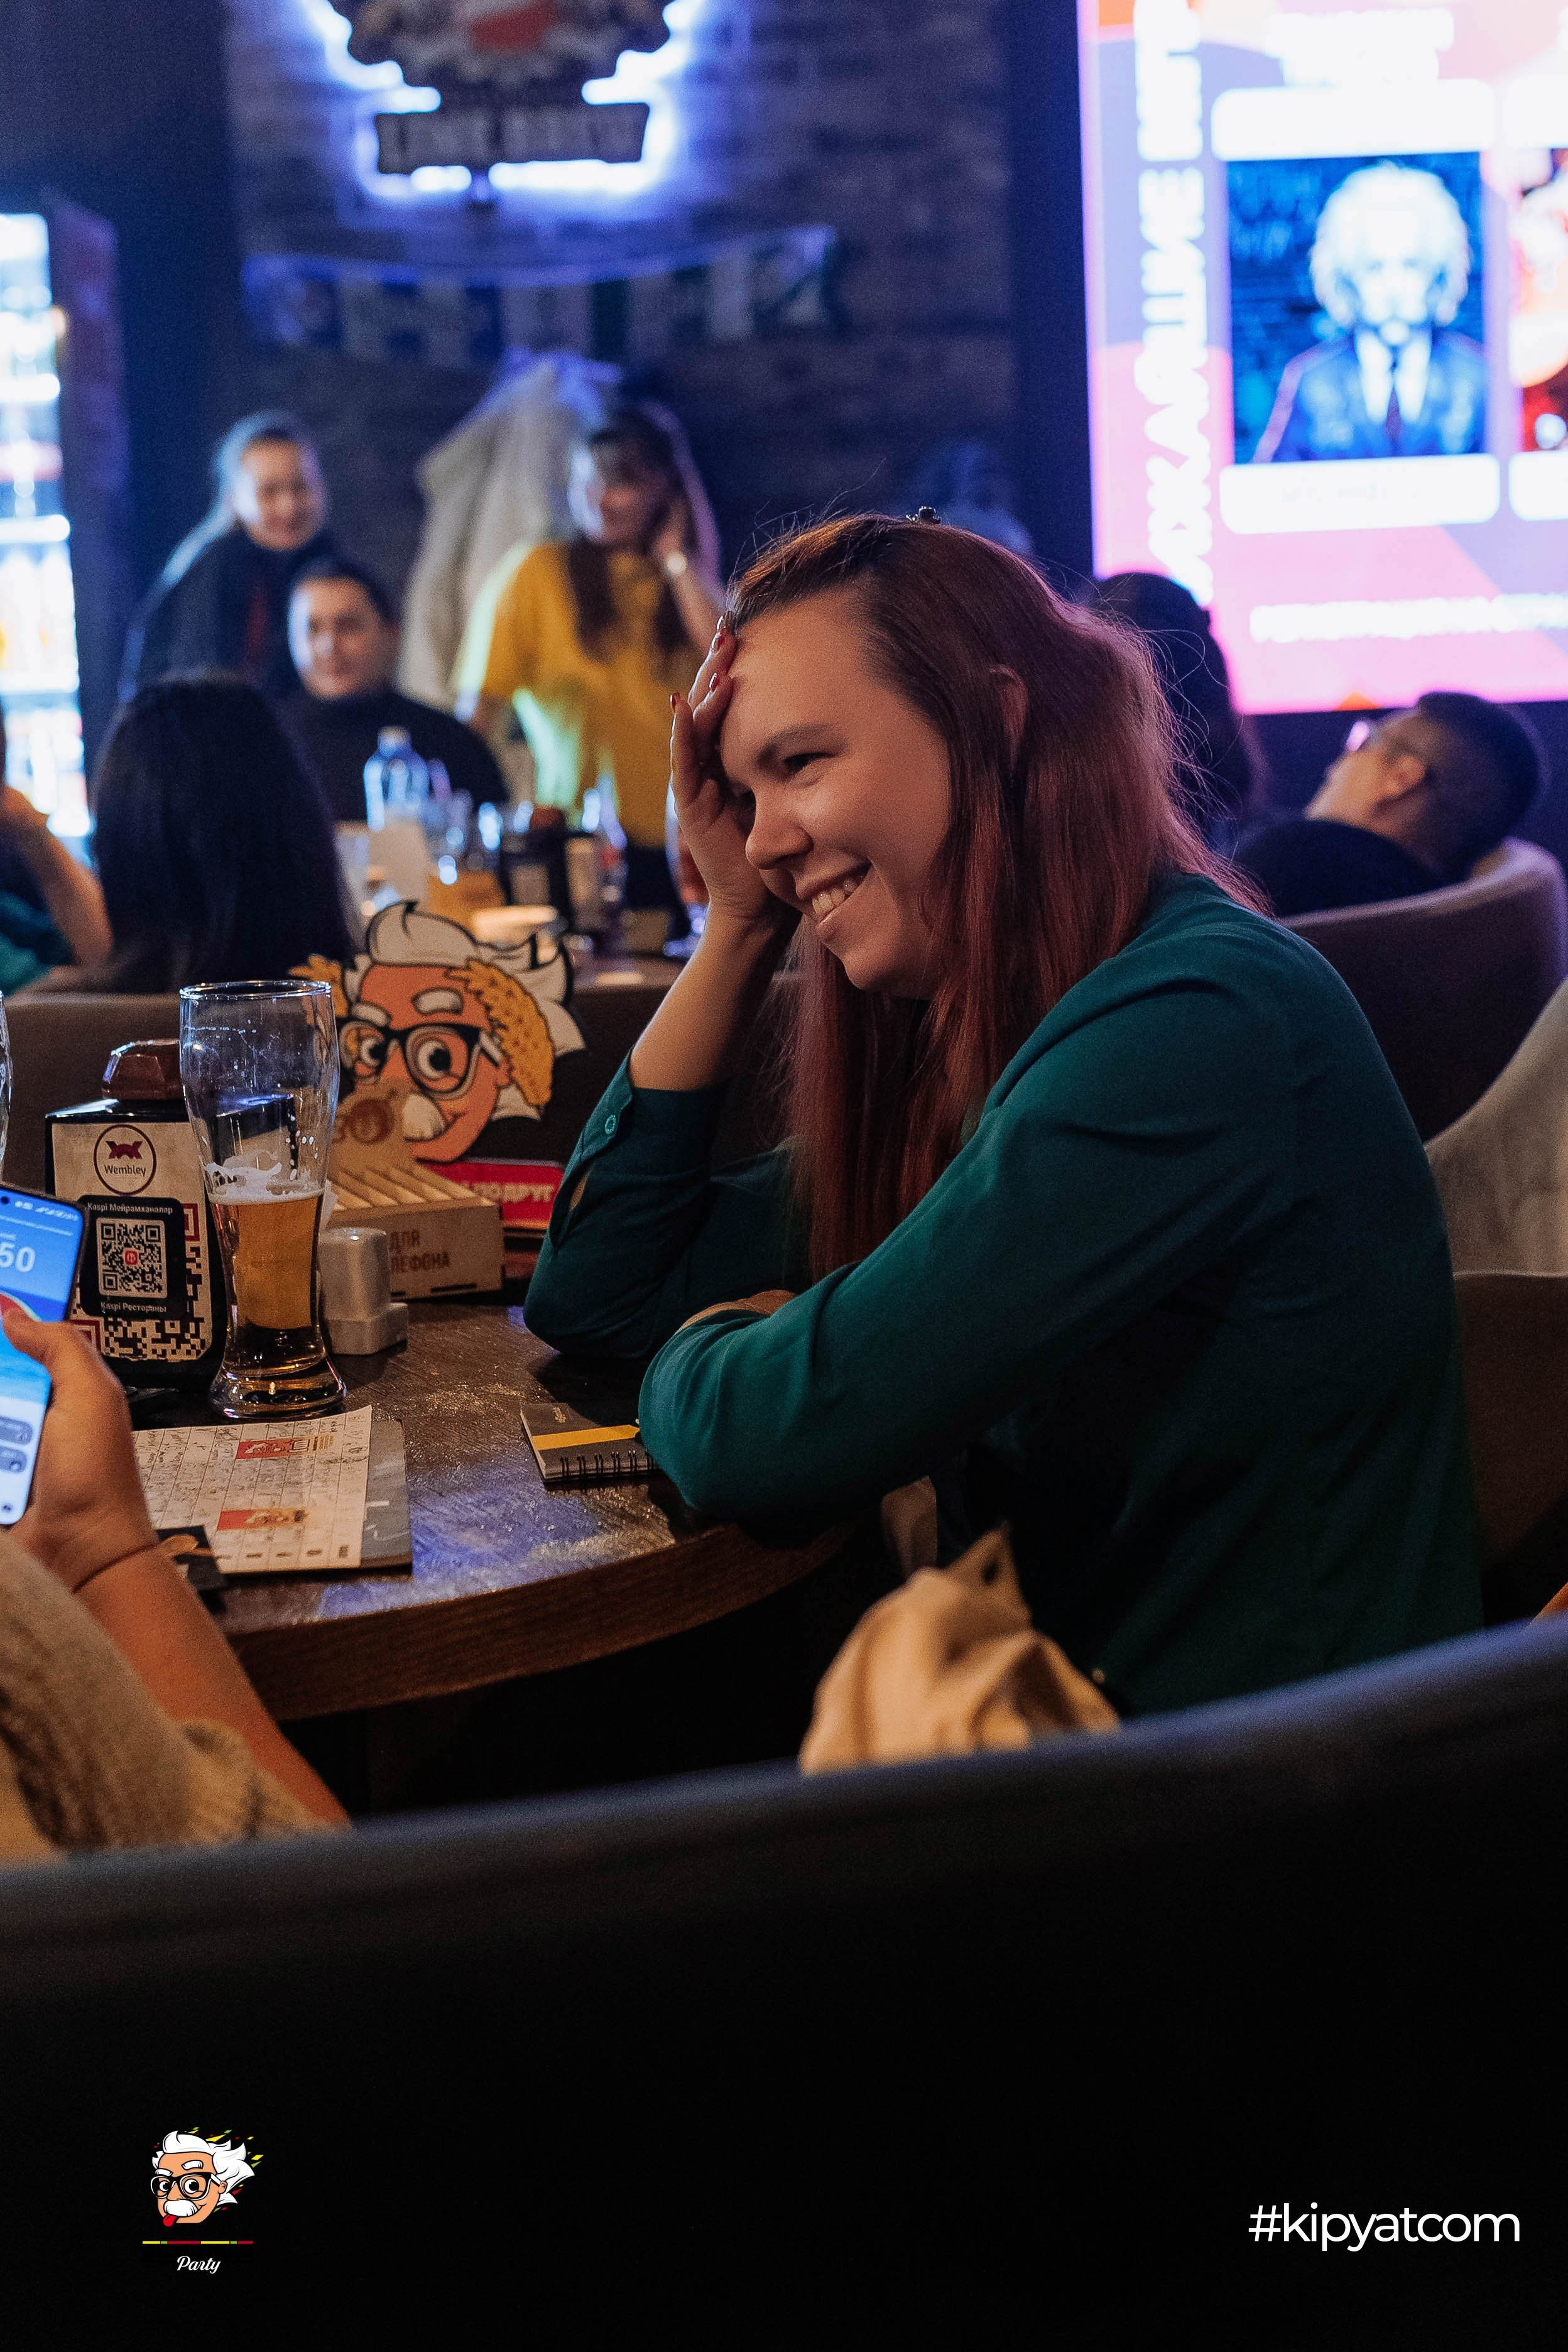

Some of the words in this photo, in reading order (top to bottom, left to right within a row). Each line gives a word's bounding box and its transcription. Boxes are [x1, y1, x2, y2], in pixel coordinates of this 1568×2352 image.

[104, 1165, 146, 1177] Wembley
[88, 1202, 108, 1212] Kaspi
[109, 1203, 173, 1214] Мейрамханалар
[391, 1252, 450, 1273] ЛЕФОНА
[101, 1301, 121, 1312] Kaspi
[122, 1302, 166, 1313] Рестораны
